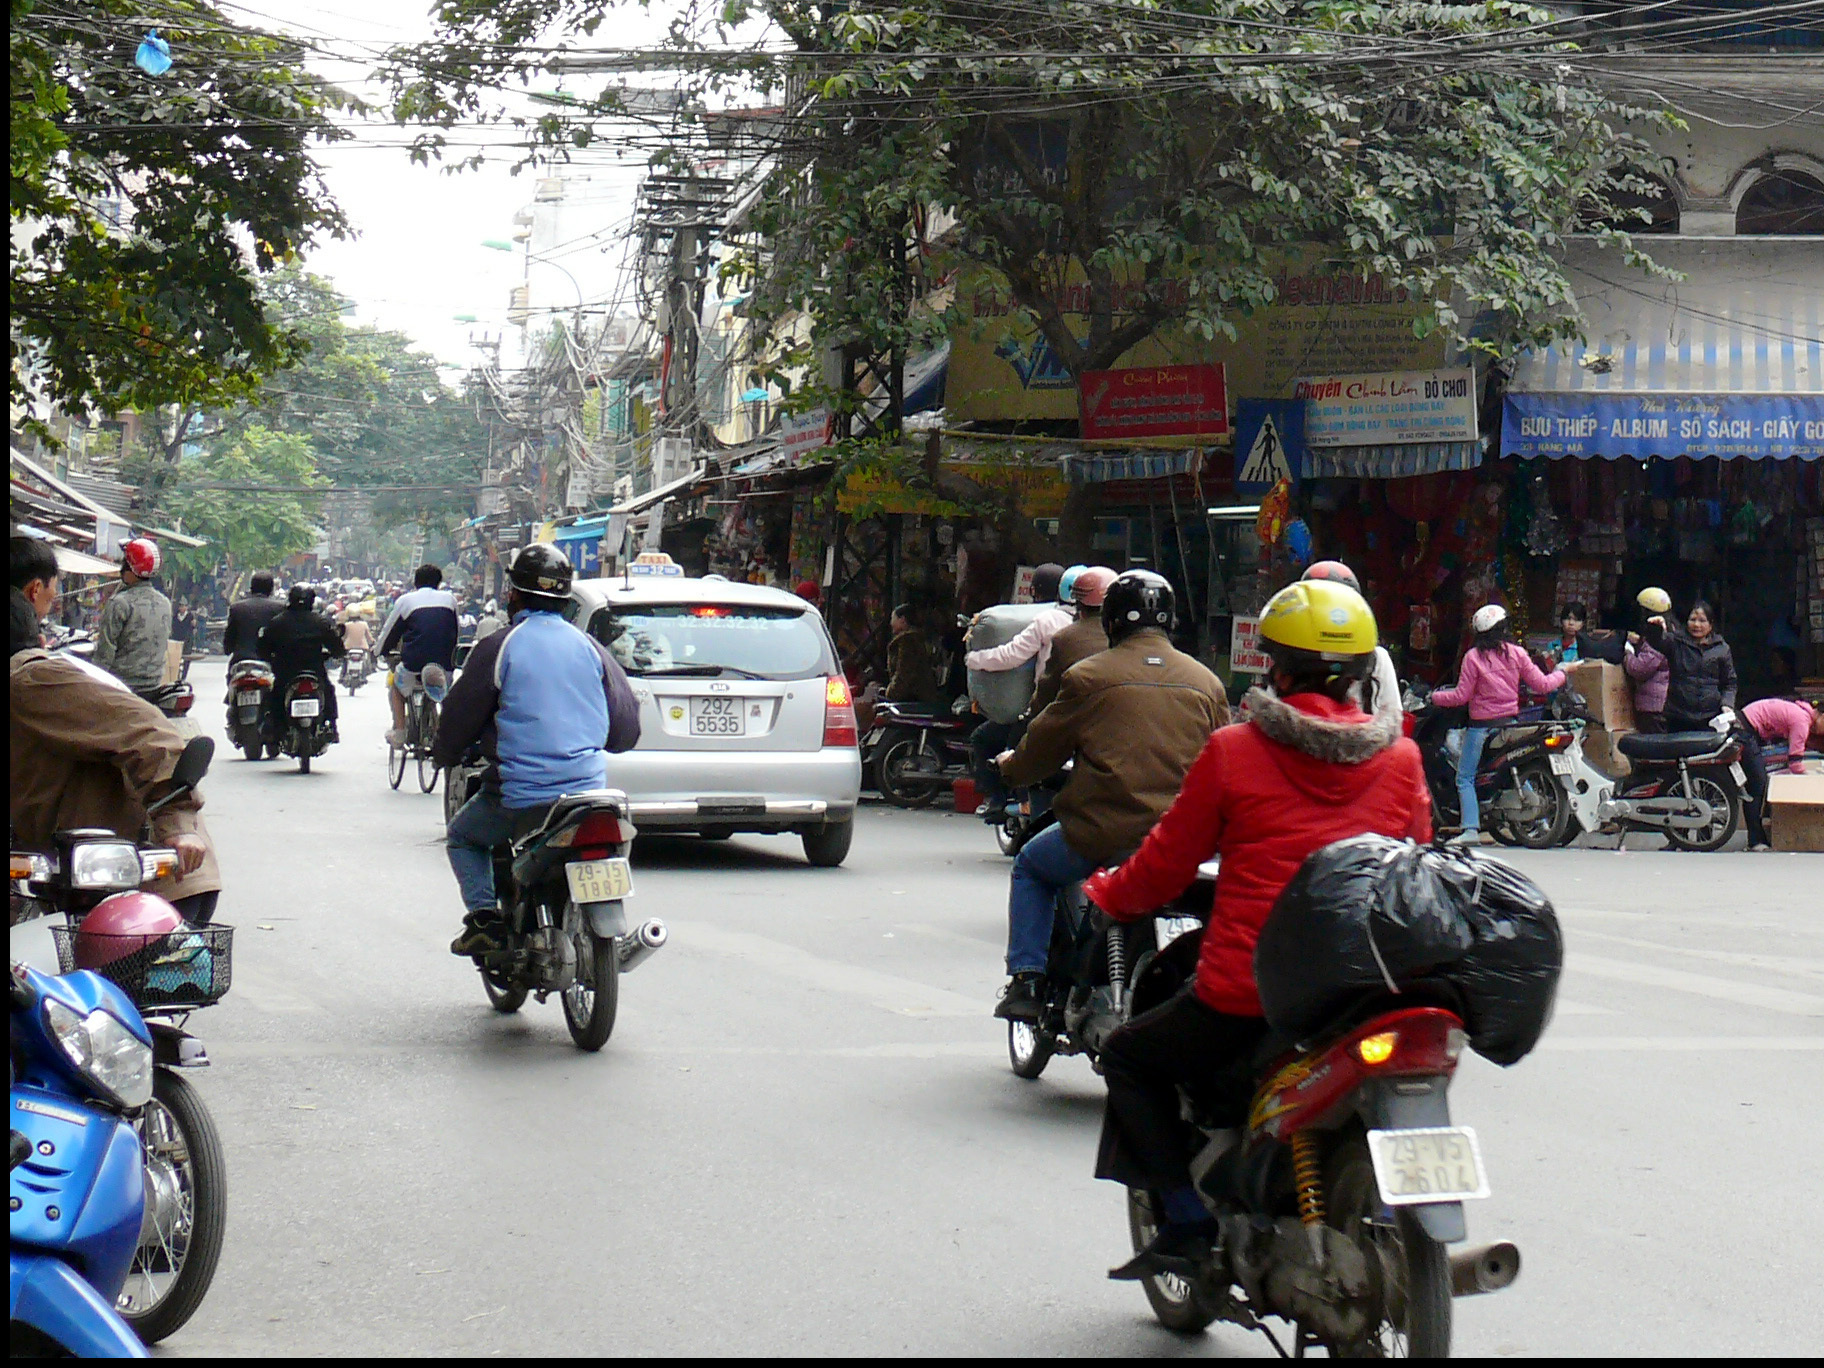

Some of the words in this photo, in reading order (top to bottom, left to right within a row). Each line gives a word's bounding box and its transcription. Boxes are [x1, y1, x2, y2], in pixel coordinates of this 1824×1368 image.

[1556, 412, 1598, 438] THIẾP
[1611, 418, 1668, 439] ALBUM
[1707, 416, 1751, 440] SÁCH
[1762, 415, 1800, 439] GIẤY
[640, 555, 667, 564] TAXI
[702, 698, 734, 715] 29Z
[696, 717, 739, 733] 5535
